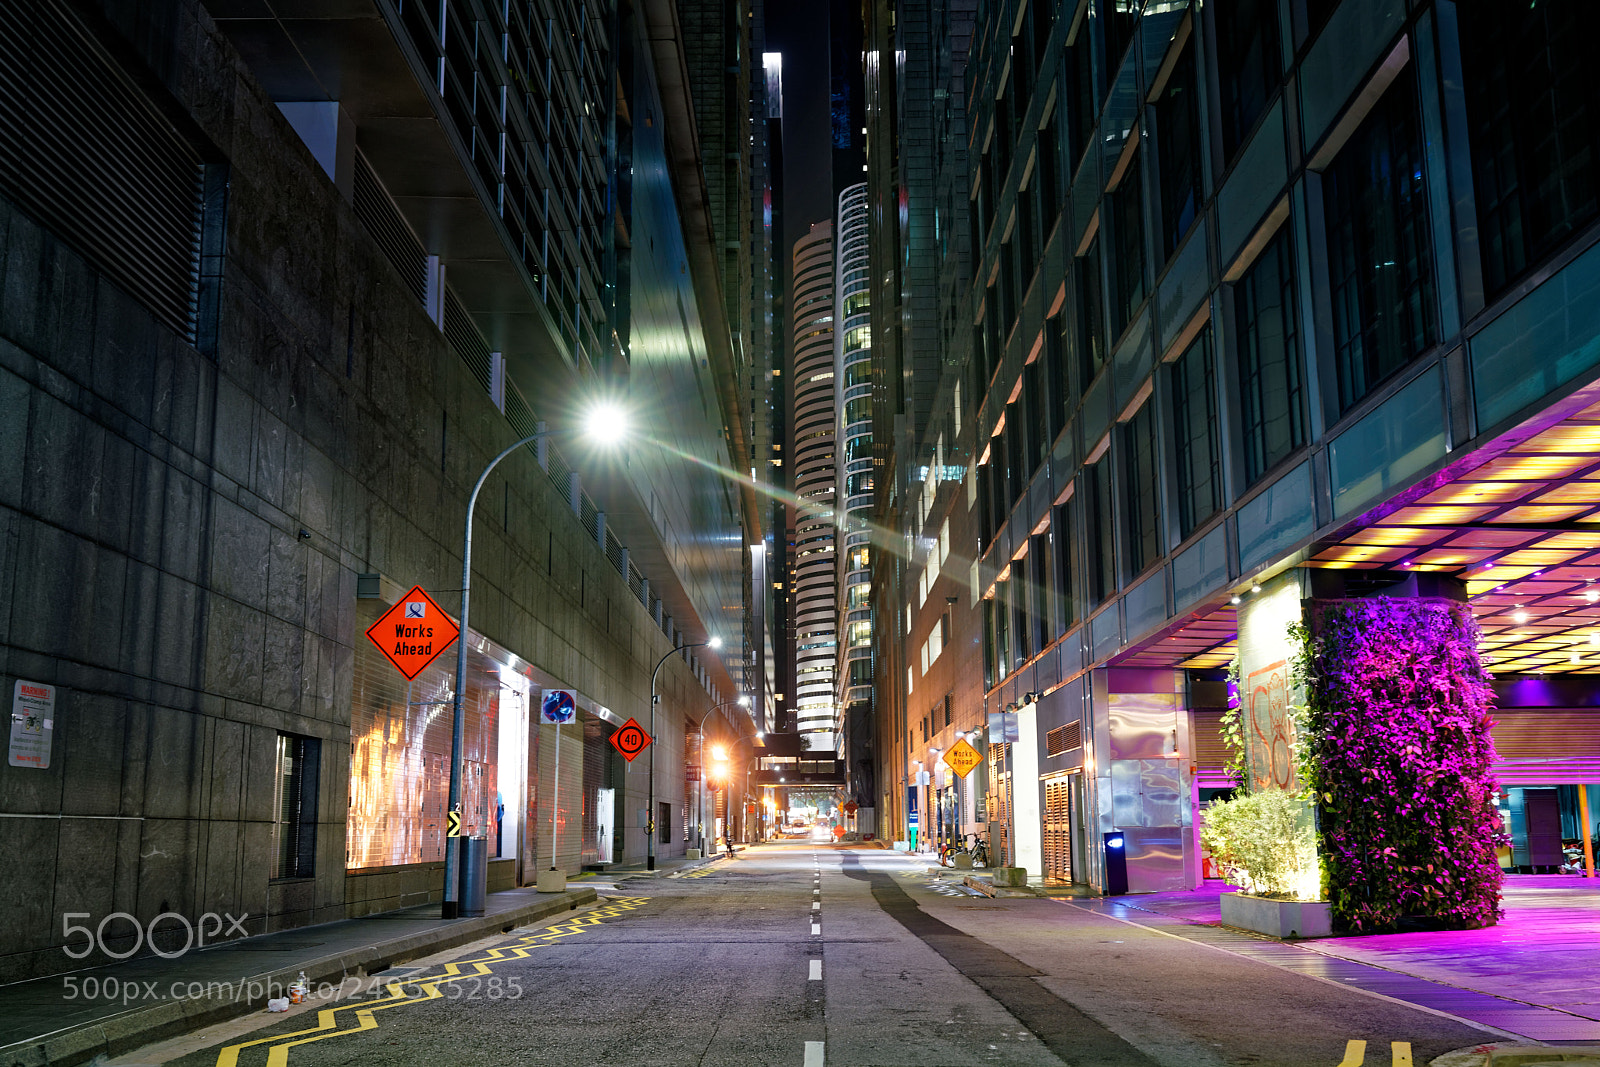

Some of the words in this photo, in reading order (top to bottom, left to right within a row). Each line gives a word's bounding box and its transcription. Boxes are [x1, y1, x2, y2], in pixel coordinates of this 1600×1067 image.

[395, 624, 433, 638] Works
[394, 642, 432, 655] Ahead
[624, 734, 637, 746] 40
